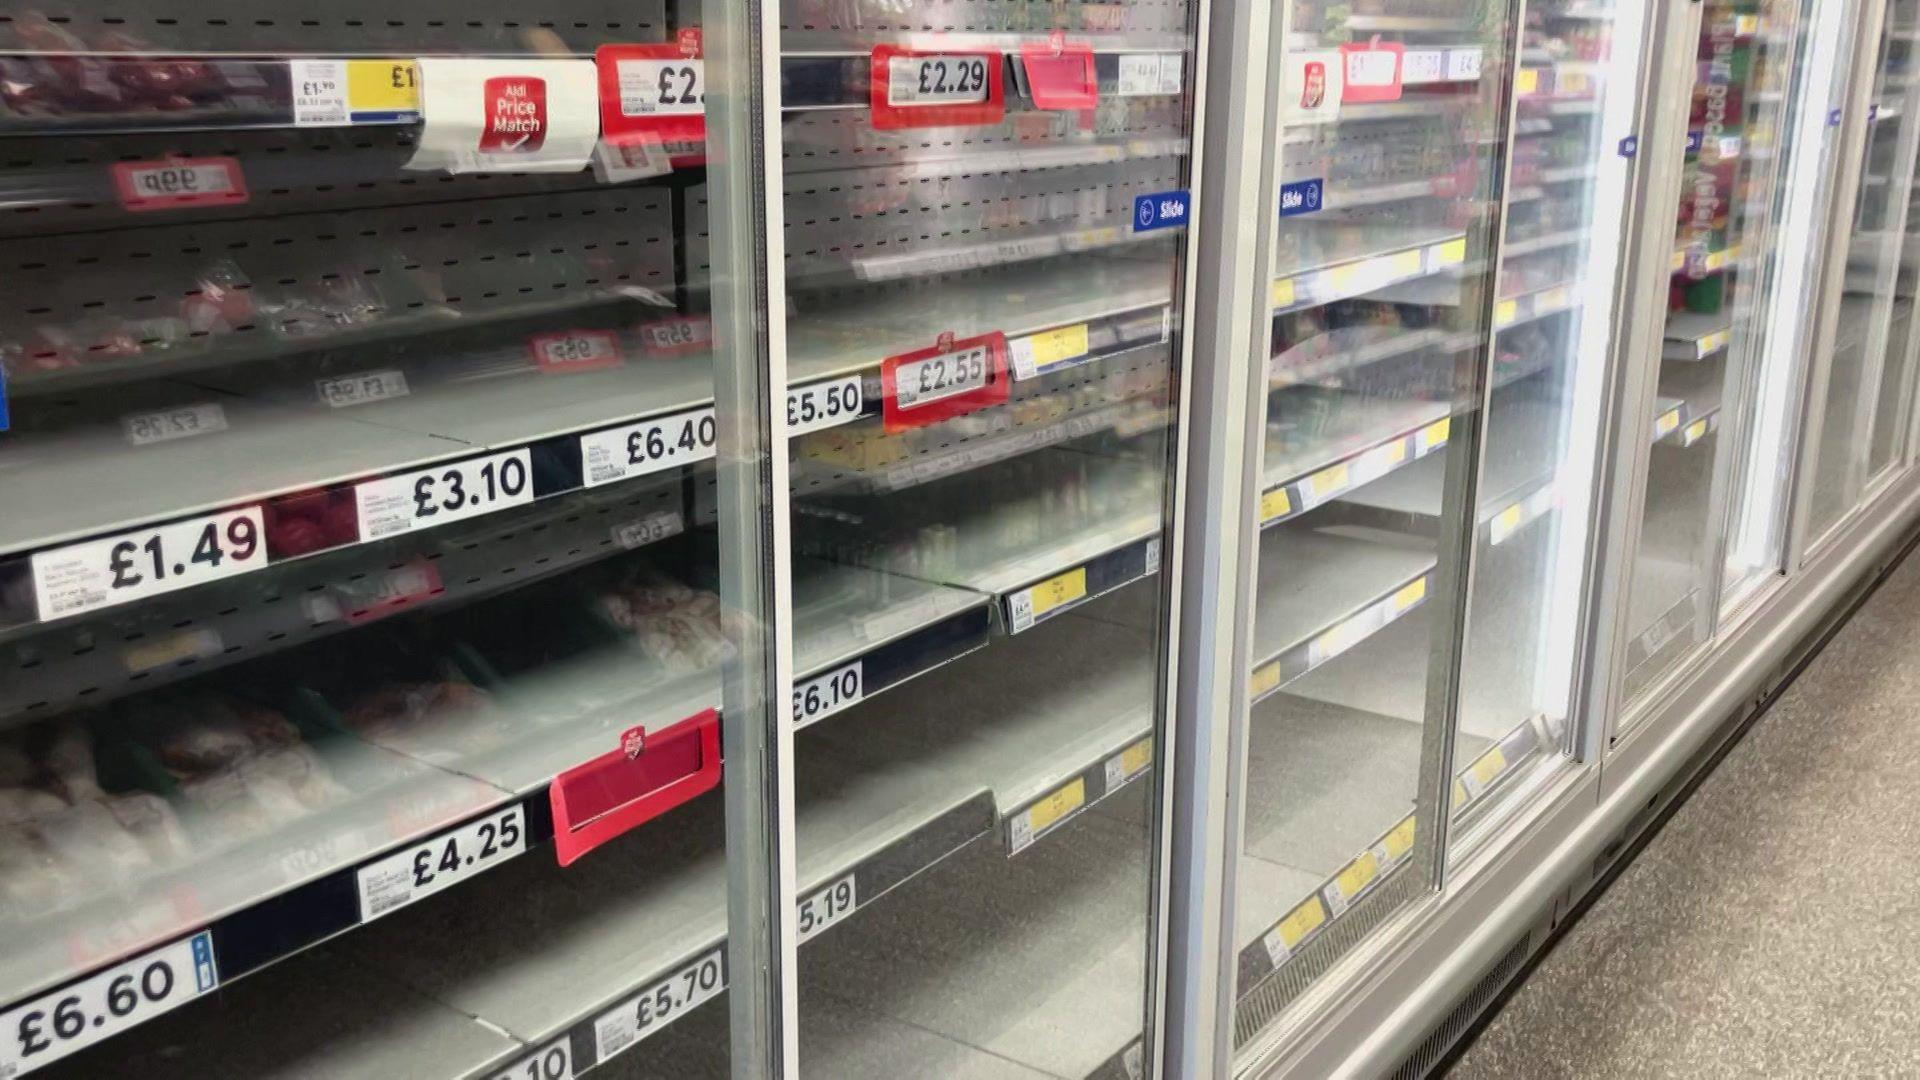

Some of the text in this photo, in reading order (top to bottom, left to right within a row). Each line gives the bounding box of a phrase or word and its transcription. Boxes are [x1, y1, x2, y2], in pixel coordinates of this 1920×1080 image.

[505, 84, 527, 97] Aldi
[918, 60, 984, 93] £2.29
[493, 117, 540, 132] Match
[497, 99, 536, 115] Price
[1160, 199, 1184, 219] Slide
[1281, 190, 1303, 208] Slide
[919, 350, 982, 393] £2.55
[787, 383, 858, 426] £5.50
[627, 415, 716, 465] £6.40
[413, 457, 526, 518] £3.10
[110, 516, 257, 589] £1.49
[413, 812, 519, 887] £4.25
[799, 881, 851, 933] 5.19
[18, 960, 174, 1057] £6.60
[635, 960, 717, 1031] £5.70
